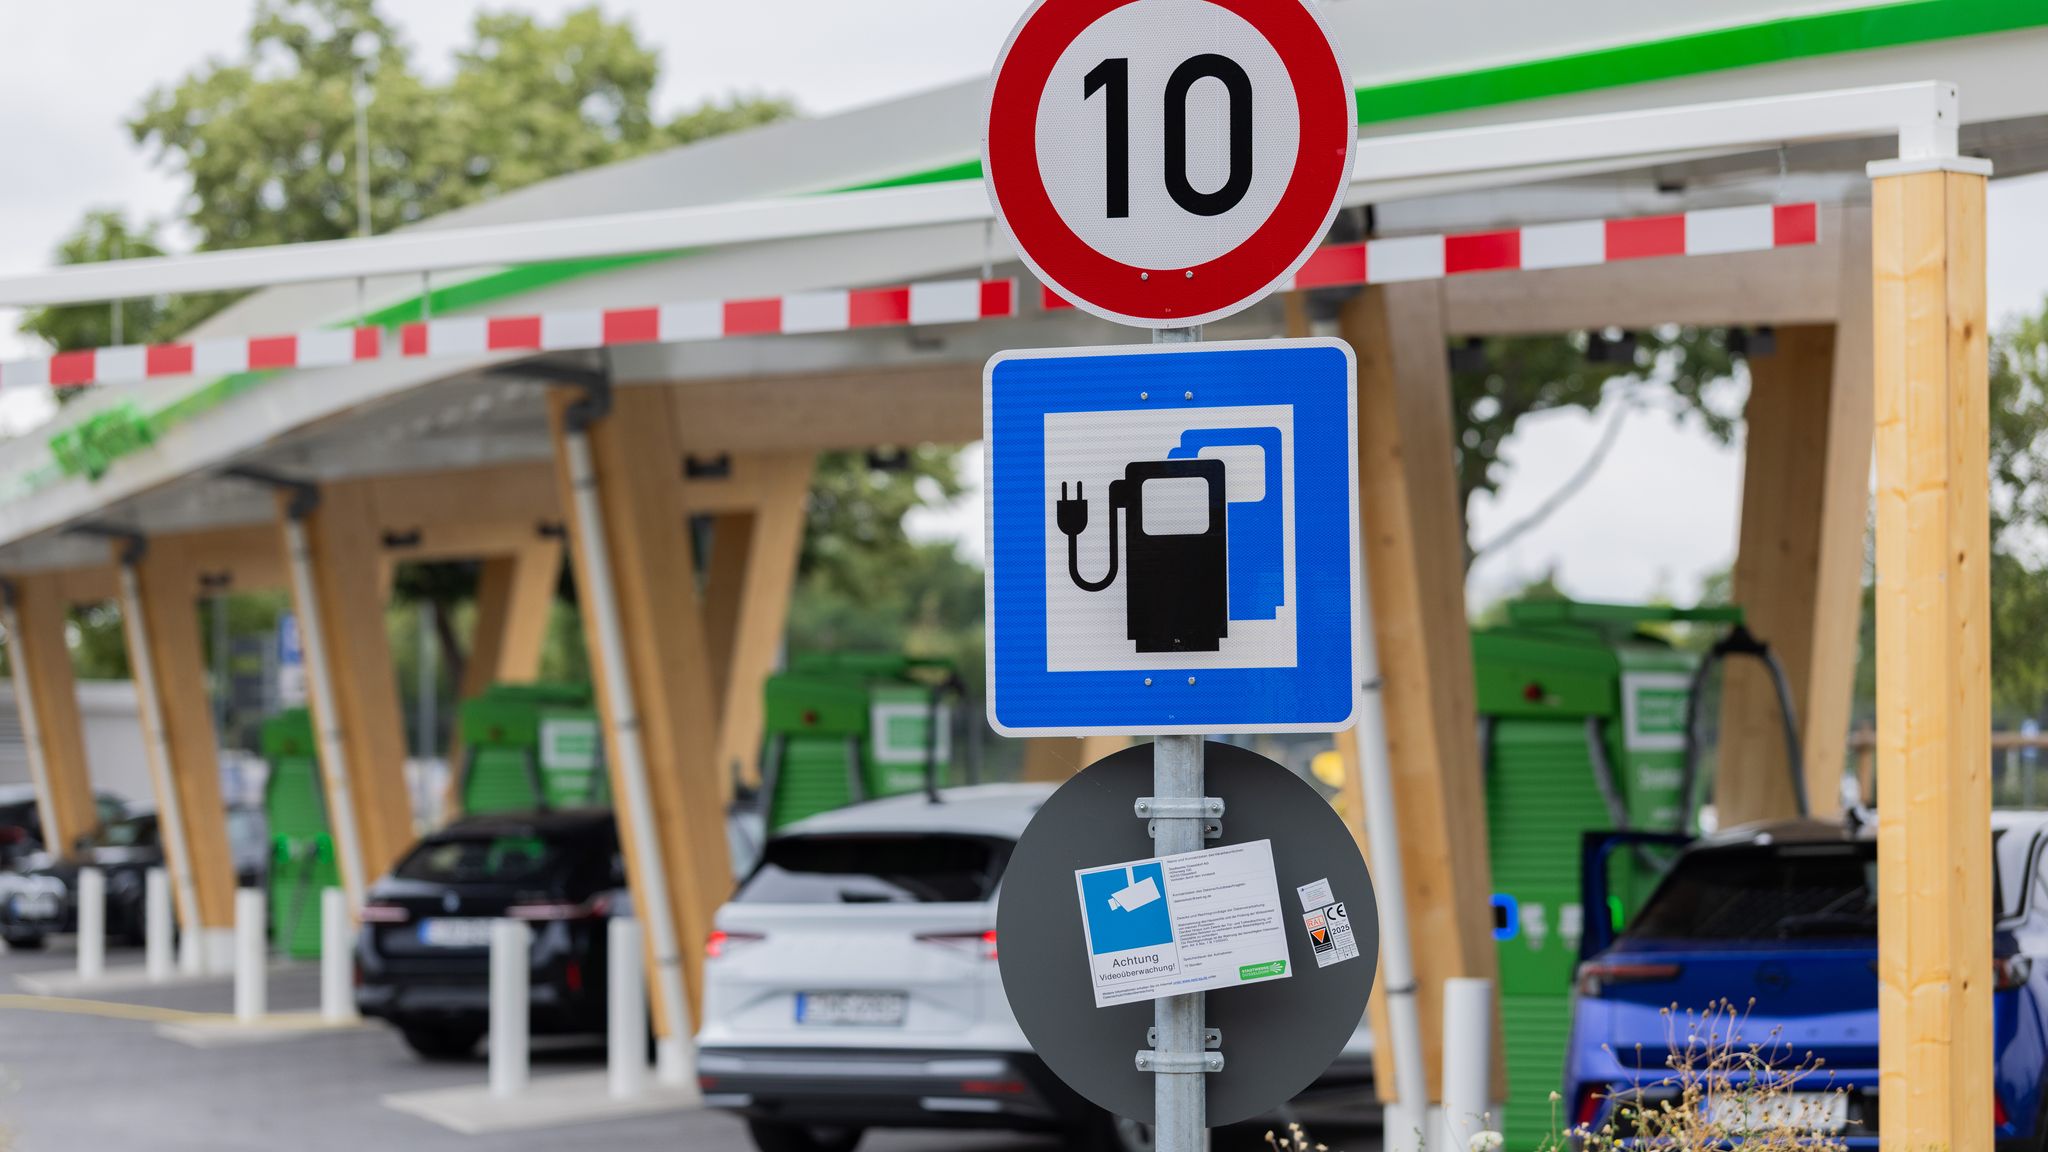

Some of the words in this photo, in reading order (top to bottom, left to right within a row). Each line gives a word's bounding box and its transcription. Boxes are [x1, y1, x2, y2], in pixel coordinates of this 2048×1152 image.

[1083, 53, 1253, 219] 10
[1332, 924, 1350, 935] 2025
[1112, 953, 1159, 968] Achtung
[1099, 963, 1176, 981] Videoüberwachung!
